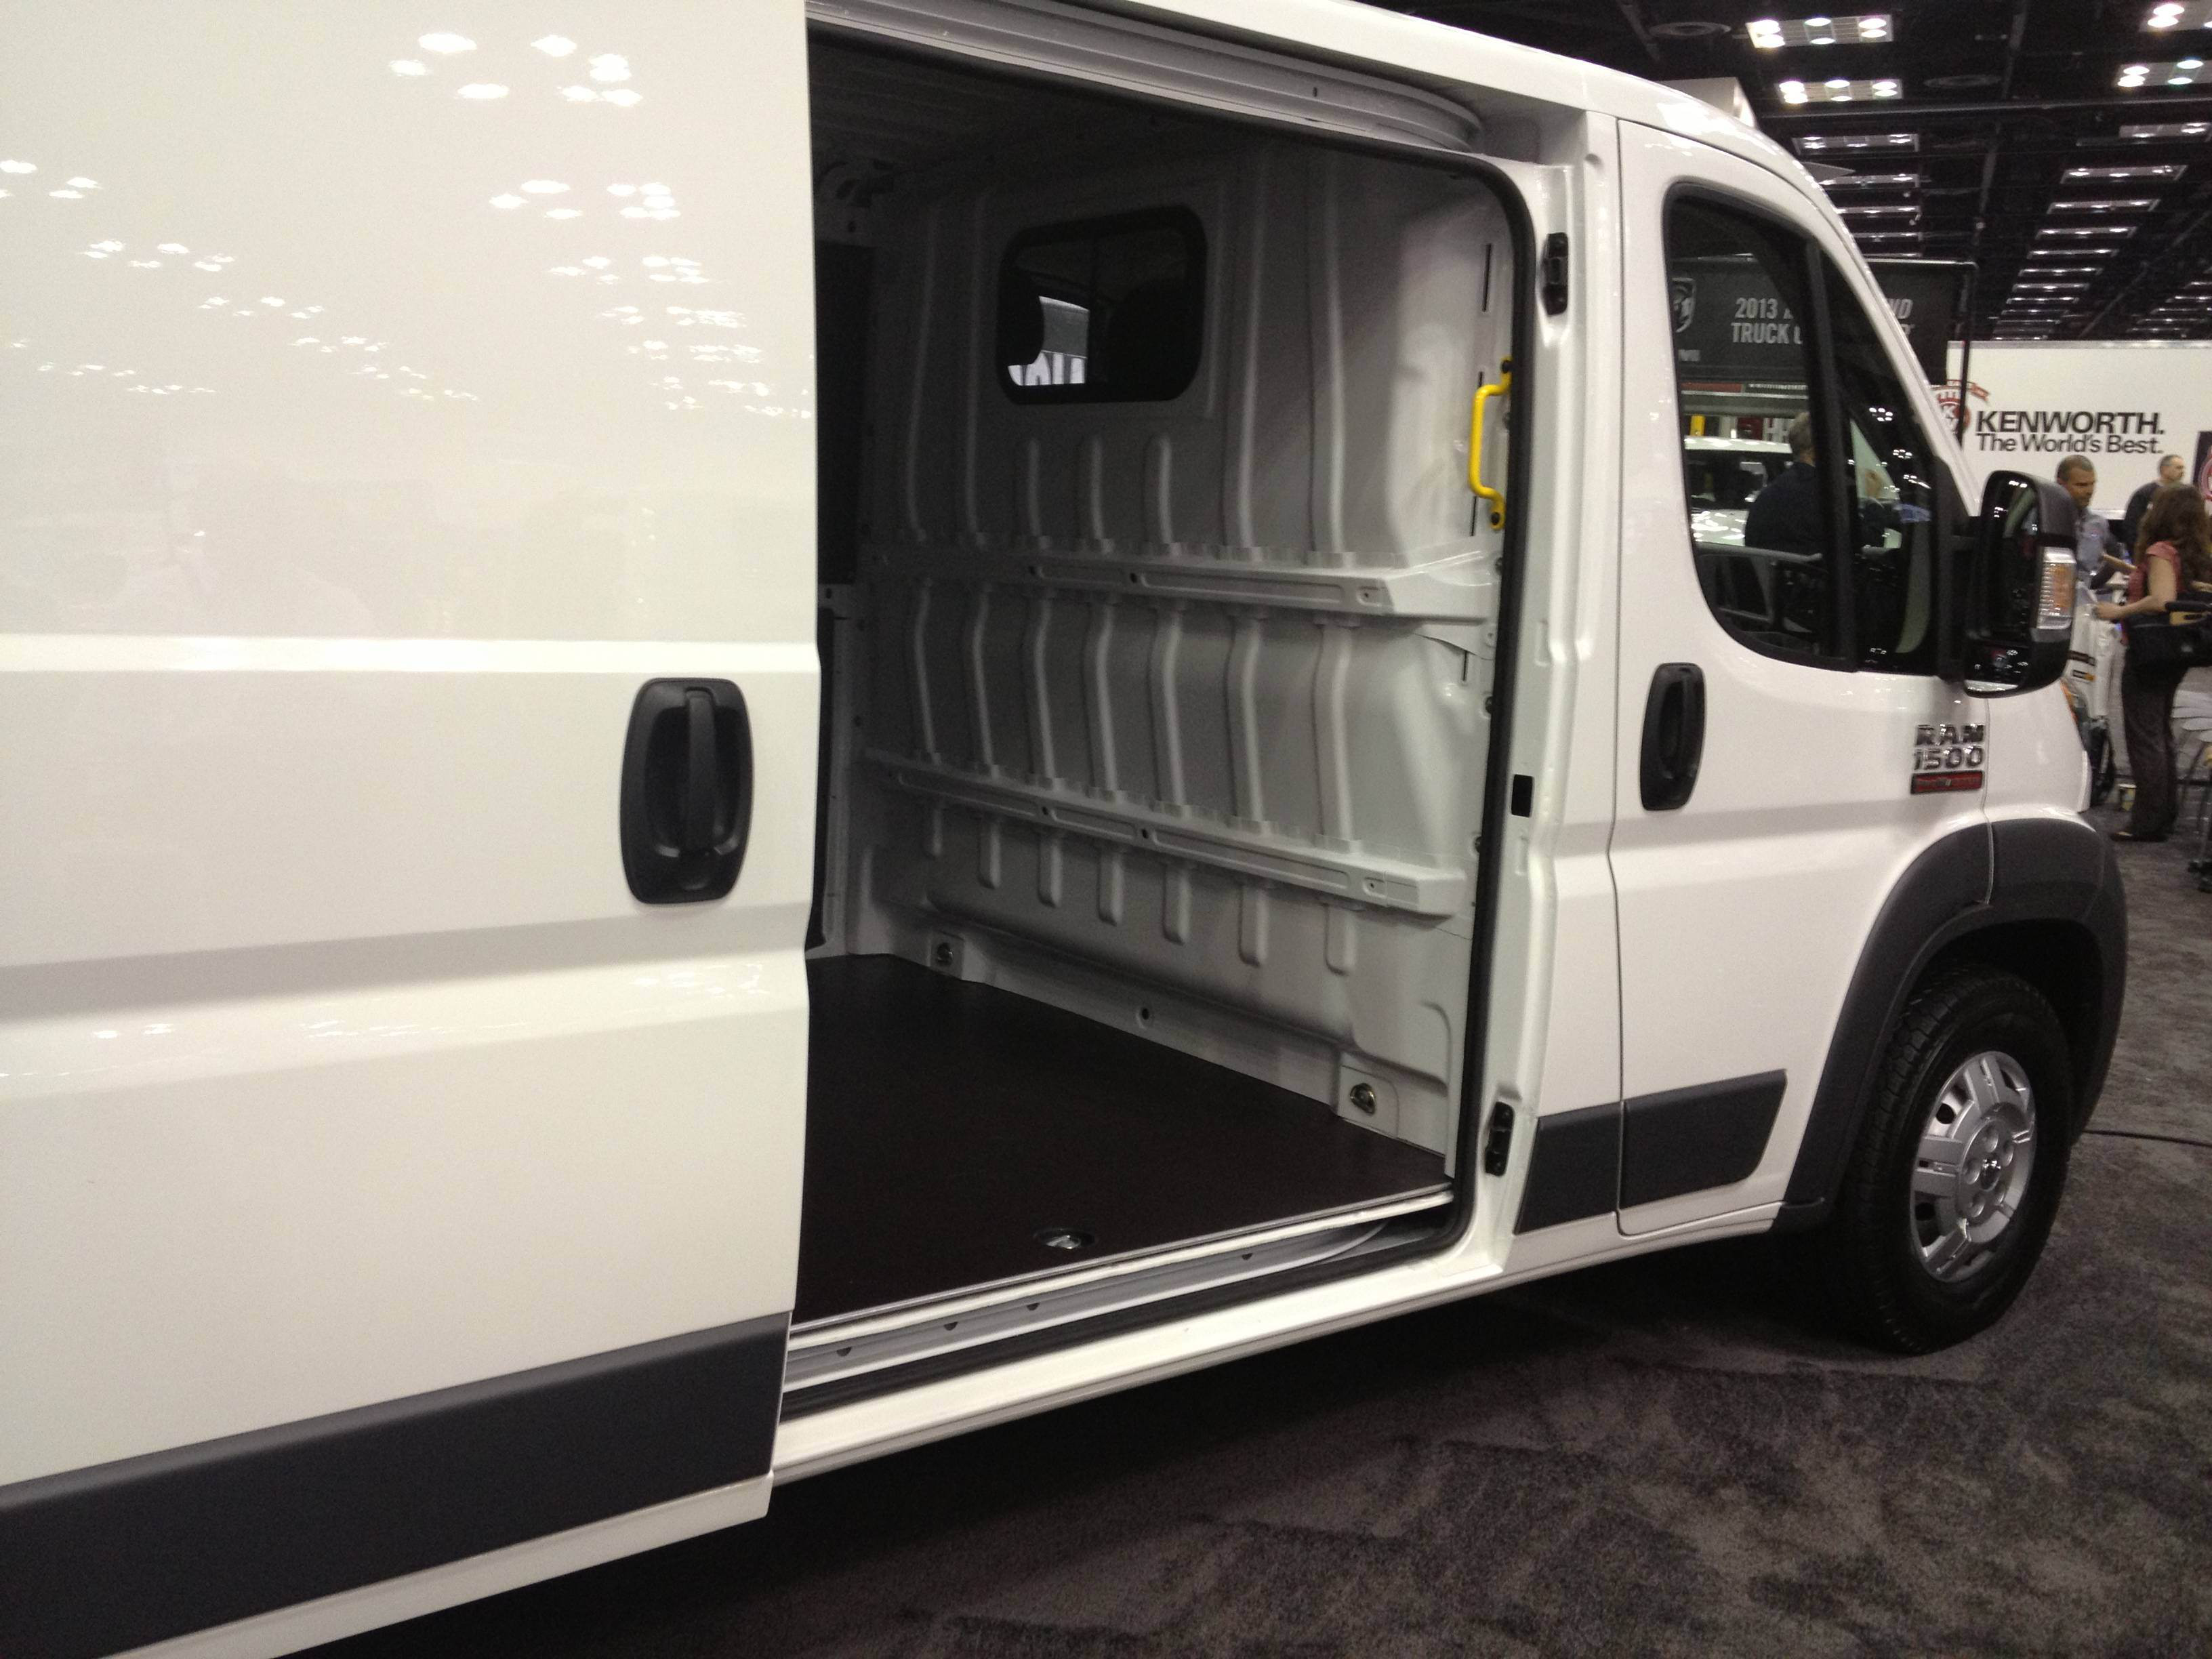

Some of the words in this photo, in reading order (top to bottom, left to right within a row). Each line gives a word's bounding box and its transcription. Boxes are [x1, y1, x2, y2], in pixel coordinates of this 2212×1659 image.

[1734, 297, 1778, 319] 2013
[1730, 322, 1790, 344] TRUCK
[1975, 410, 2165, 434] KENWORTH.
[1975, 432, 2017, 452] The
[2021, 433, 2101, 453] World's
[2106, 434, 2164, 454] Best.
[1913, 745, 1984, 770] 1500
